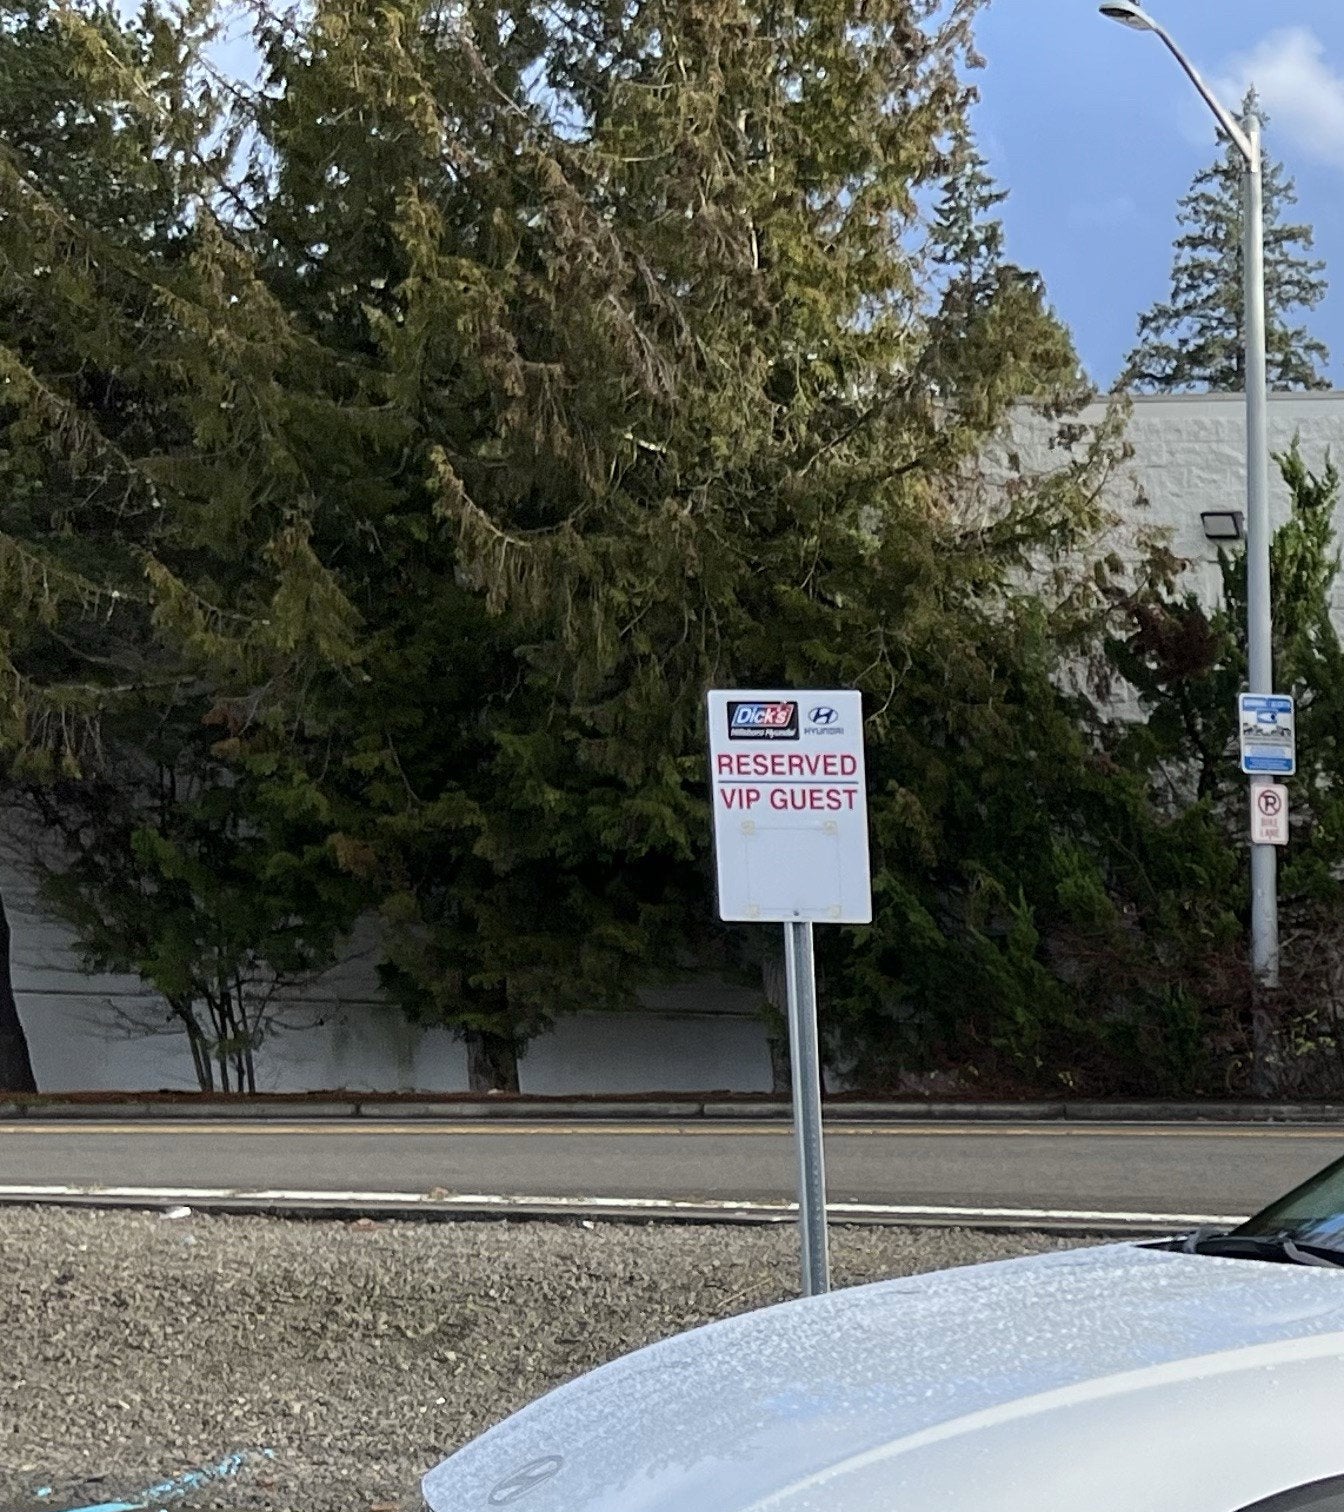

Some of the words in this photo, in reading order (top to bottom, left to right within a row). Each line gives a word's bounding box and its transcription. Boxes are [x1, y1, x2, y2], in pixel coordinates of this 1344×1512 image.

[737, 706, 787, 724] Dick's
[716, 753, 858, 776] RESERVED
[720, 788, 761, 809] VIP
[769, 788, 858, 810] GUEST
